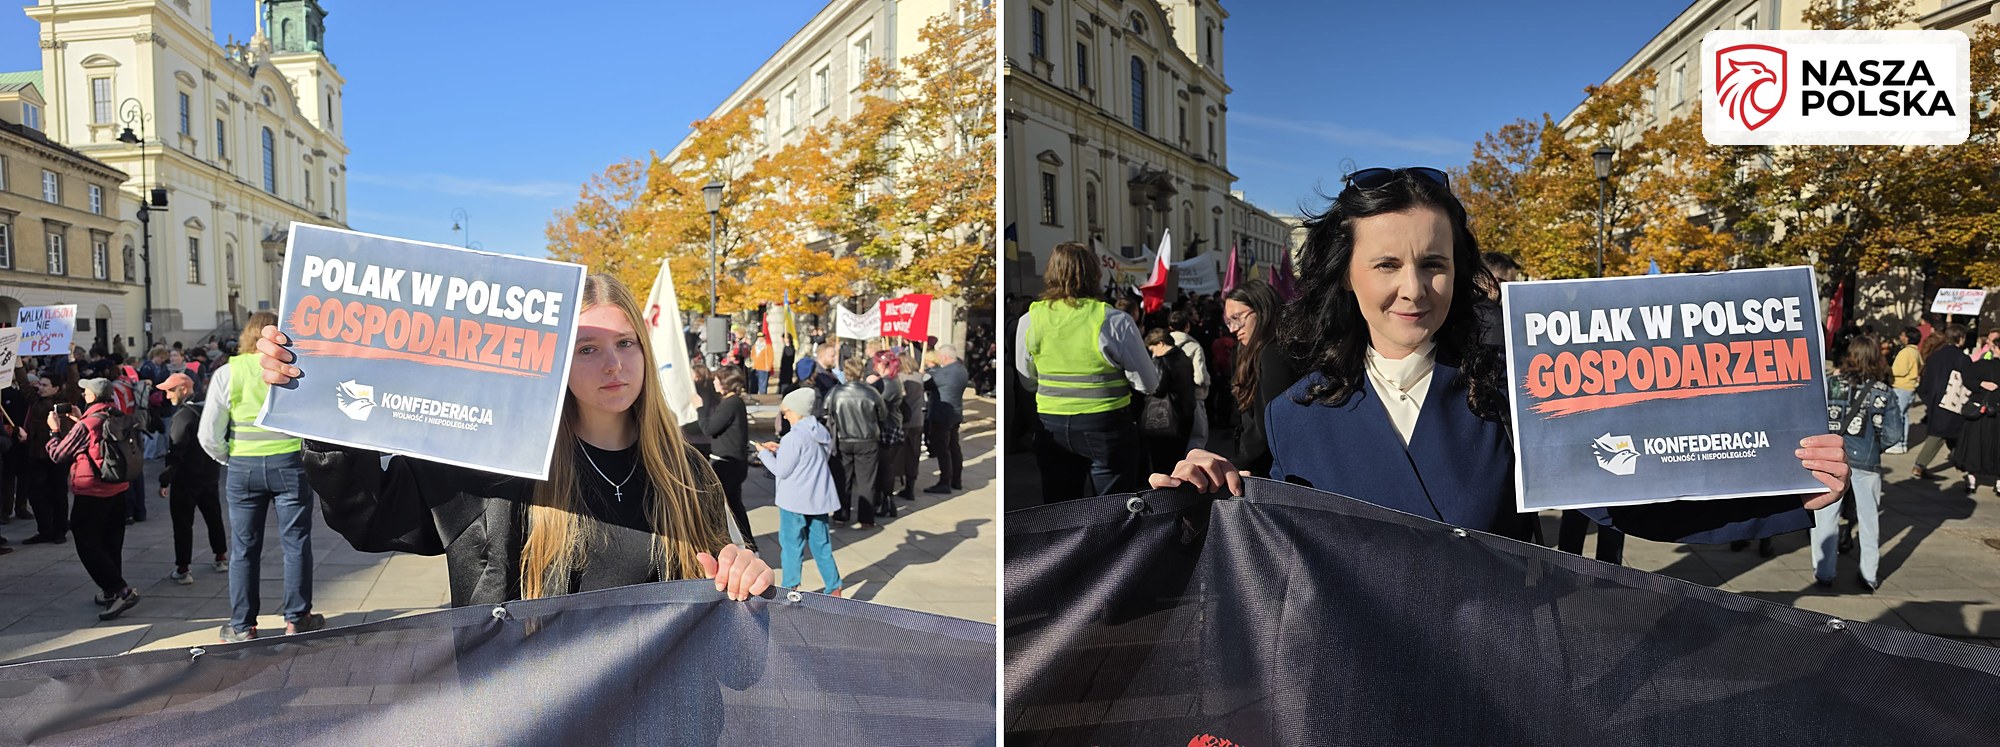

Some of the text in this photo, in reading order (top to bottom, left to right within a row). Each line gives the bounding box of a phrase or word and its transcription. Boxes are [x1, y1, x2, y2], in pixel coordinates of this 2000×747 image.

[302, 255, 563, 326] POLAK W POLSCE
[20, 309, 43, 323] WALKA
[36, 320, 50, 330] NIE
[1525, 296, 1803, 346] POLAK W POLSCE
[31, 340, 51, 352] PPS
[296, 295, 558, 373] GOSPODARZEM
[1527, 337, 1811, 399] GOSPODARZEM
[381, 392, 493, 425] KONFEDERACJA
[392, 411, 424, 423] WOLNOŚĆ
[428, 417, 478, 431] NIEPODLEGŁOŚĆ
[1644, 431, 1770, 455] KONFEDERACJA
[1661, 452, 1696, 463] WOLNOŚĆ
[1702, 449, 1757, 461] NIEPODLEGŁOŚĆ
